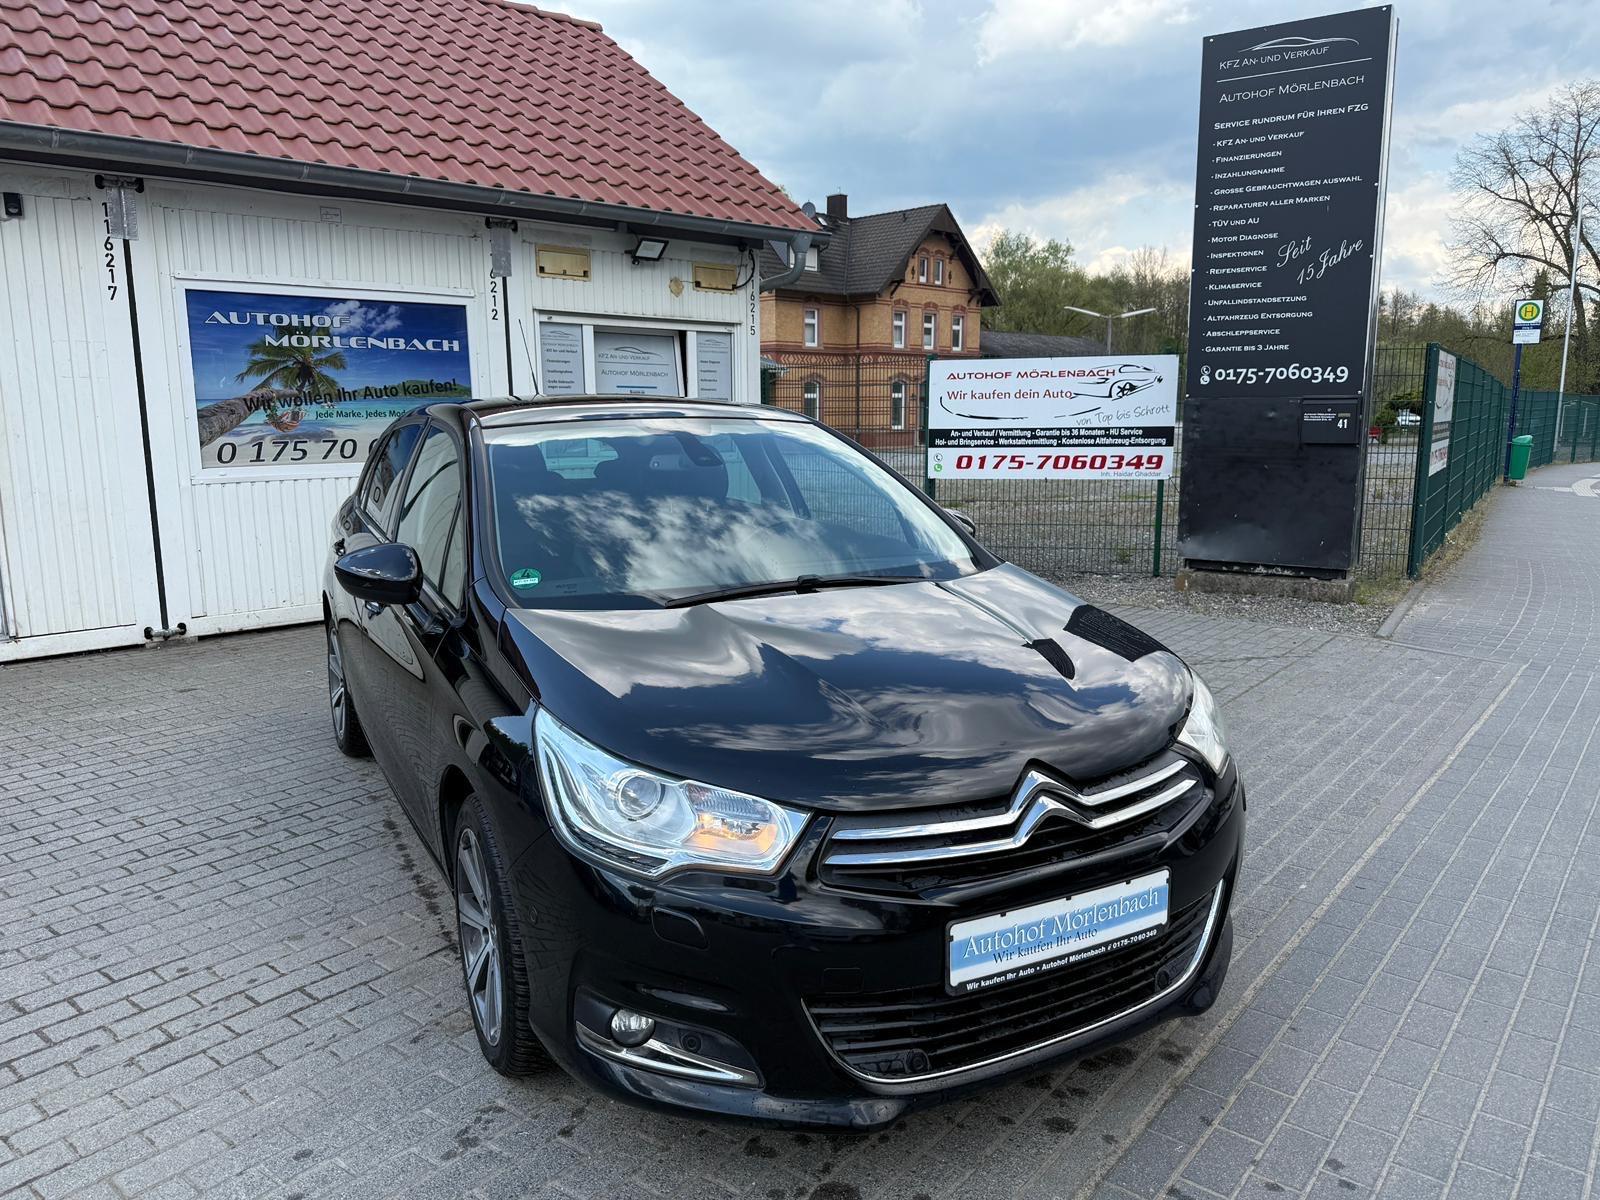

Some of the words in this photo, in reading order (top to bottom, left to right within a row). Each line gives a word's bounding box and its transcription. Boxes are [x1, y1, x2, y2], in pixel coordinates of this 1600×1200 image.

[1218, 59, 1240, 70] KFZ
[1260, 54, 1281, 64] UND
[1283, 46, 1330, 61] VERKAUF
[1218, 87, 1276, 104] AUTOHOF
[1278, 74, 1365, 95] MÖRLENBACH
[1213, 119, 1251, 130] SERVICE
[1252, 113, 1296, 126] RUNDRUM
[1297, 109, 1315, 120] FÜR
[1316, 106, 1346, 117] IHREN
[1347, 103, 1369, 113] FZG
[1216, 139, 1233, 147] KFZ
[1249, 135, 1266, 144] UND
[1267, 131, 1305, 142] VERKAUF
[1215, 150, 1283, 164] FINANZIERUNGEN
[1214, 167, 1286, 180] INZAHLUNGNAHME
[1213, 186, 1245, 196] GROSSE
[1245, 179, 1322, 193] GEBRAUCHTWAGEN
[1322, 175, 1363, 185] AUSWAHL
[1212, 200, 1269, 212] REPARATUREN
[1269, 198, 1294, 207] ALLER
[1295, 195, 1331, 205] MARKEN
[1212, 218, 1229, 227] TÜV
[1230, 218, 1246, 226] UND
[1247, 217, 1260, 225] AU
[1211, 236, 1238, 244] MOTOR
[1239, 232, 1279, 241] DIAGNOSE
[101, 202, 118, 301] 116217
[1210, 249, 1264, 260] INSPEKTIONEN
[1276, 236, 1312, 268] Seit
[1296, 262, 1315, 285] 15
[1316, 238, 1364, 279] Jahre
[1209, 265, 1268, 275] REIFENSERVICE
[1208, 281, 1263, 291] KLIMASERVICE
[1206, 312, 1259, 322] ALTFAHRZEUG
[1260, 311, 1313, 320] ENTSORGUNG
[1525, 306, 1534, 317] H
[204, 311, 351, 329] AUTOHOF
[1206, 328, 1281, 337] ABSCHLEPPSERVICE
[265, 331, 460, 352] MÖRLENBACH
[1205, 345, 1243, 353] GARANTIE
[601, 369, 629, 377] AUTOHOF
[630, 370, 669, 378] MÖRLENBACH
[947, 371, 1012, 380] AUTOHOF
[1016, 368, 1116, 379] MÖRLENBACH
[1214, 363, 1349, 384] 0175-7060349
[243, 397, 272, 411] Wir
[278, 391, 334, 408] wollen
[337, 387, 358, 402] Ihr
[363, 385, 398, 400] Auto
[402, 379, 458, 397] kaufen!
[947, 390, 969, 401] Wir
[971, 388, 1011, 401] kaufen
[1014, 388, 1040, 400] dein
[1043, 389, 1072, 400] Auto
[315, 410, 334, 420] Jede
[335, 410, 364, 419] Marke.
[365, 410, 387, 420] Jedes
[1076, 418, 1092, 426] von
[1095, 411, 1114, 425] Top
[1116, 410, 1131, 421] bis
[1133, 404, 1170, 418] Schrott
[1337, 418, 1348, 429] 41
[974, 429, 995, 437] Verkauf
[999, 429, 1032, 438] Vermittlung
[1035, 429, 1060, 437] Garantie
[1061, 428, 1070, 436] bis
[1080, 428, 1105, 436] Monaten
[1120, 428, 1143, 436] Service
[959, 438, 995, 447] Bringservice
[1061, 437, 1095, 445] Kostenlose
[217, 442, 237, 465] 0
[249, 440, 308, 463] 175
[322, 438, 358, 460] 70
[955, 454, 1164, 470] 0175-7060349
[521, 569, 532, 578] 4
[963, 917, 1050, 958] Autohof
[1051, 888, 1159, 935] Mörlenbach
[992, 950, 1015, 965] Wir
[1018, 939, 1054, 958] kaufen
[1056, 934, 1072, 947] Ihr
[1074, 928, 1098, 942] Auto
[966, 982, 980, 991] Wir
[980, 975, 1006, 987] kaufen
[1006, 971, 1017, 980] Ihr
[1018, 968, 1035, 977] Auto
[1041, 957, 1068, 970] Autohof
[1069, 945, 1106, 963] Mörlenbach
